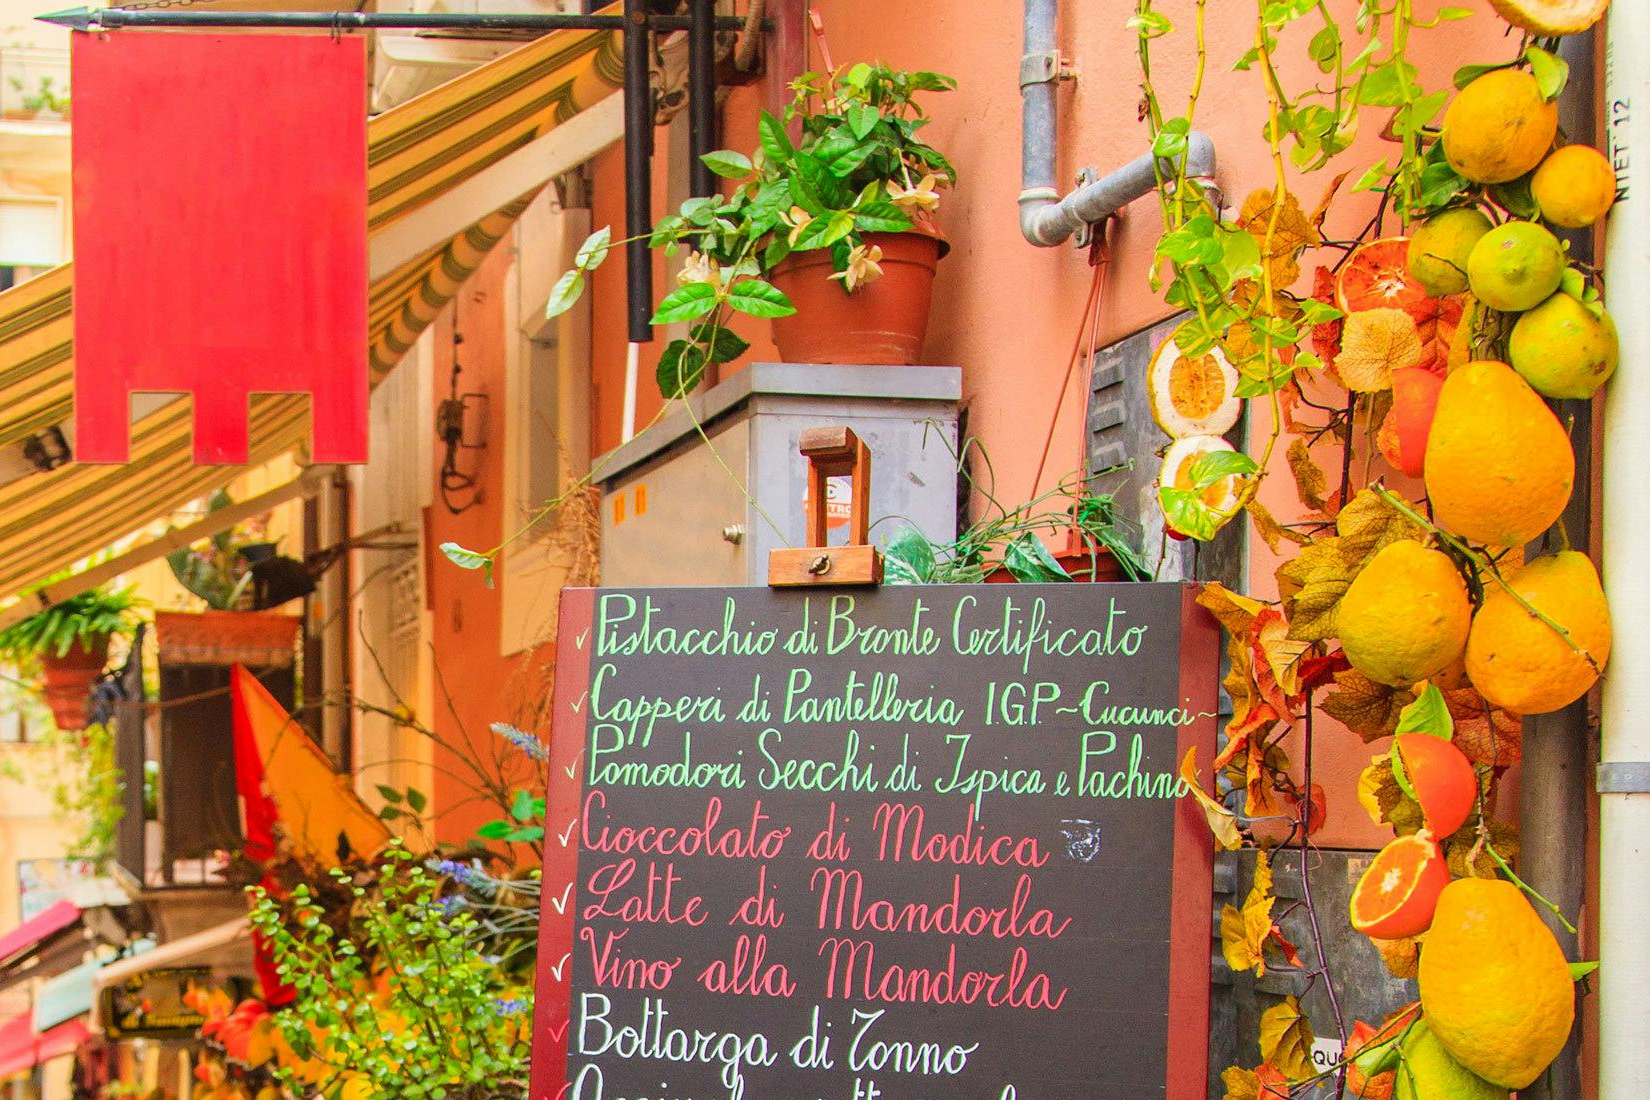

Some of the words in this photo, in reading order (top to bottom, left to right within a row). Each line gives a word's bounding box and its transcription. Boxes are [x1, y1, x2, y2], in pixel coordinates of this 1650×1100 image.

[596, 593, 779, 657] Pistacchio
[782, 596, 819, 655] di
[826, 595, 941, 656] Bronte
[952, 595, 1148, 675] Certificato
[590, 662, 726, 748] Capperi
[735, 673, 772, 723] di
[783, 668, 965, 726] Pantelleria
[589, 723, 746, 789] Pomodori
[758, 727, 879, 793] Secchi
[884, 733, 922, 792] di
[934, 733, 1047, 822] Ispica
[1053, 770, 1071, 797] e
[1076, 730, 1202, 800] Pachino
[581, 789, 792, 859] Cioccolato
[805, 801, 851, 863] di
[872, 802, 1050, 868] Modica
[582, 857, 709, 927] Latte
[728, 864, 785, 929] di
[810, 866, 1072, 939] Mandorla
[579, 926, 682, 990] Vino
[696, 933, 797, 998] alla
[818, 937, 1068, 1010] Mandorla
[578, 992, 778, 1089] Bottarga
[788, 1004, 834, 1070] di
[848, 1008, 980, 1075] Tonno
